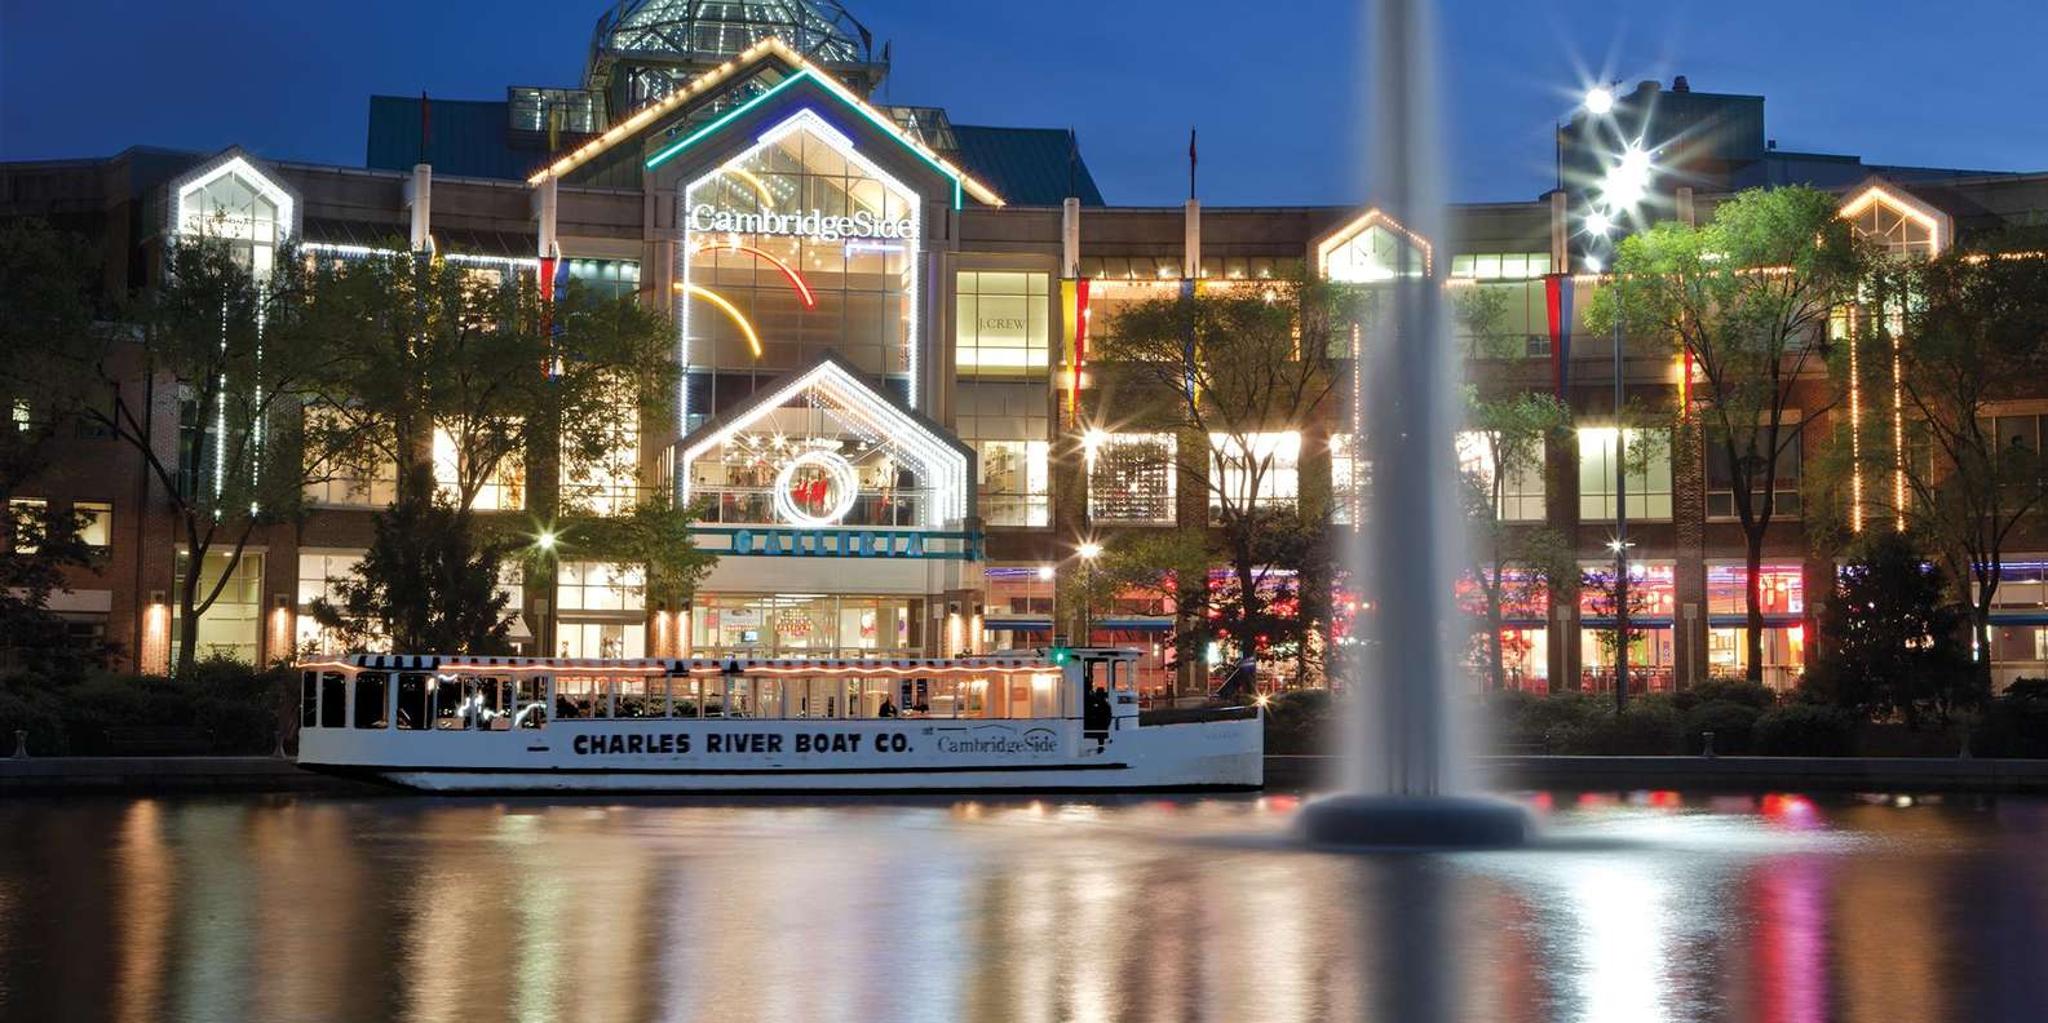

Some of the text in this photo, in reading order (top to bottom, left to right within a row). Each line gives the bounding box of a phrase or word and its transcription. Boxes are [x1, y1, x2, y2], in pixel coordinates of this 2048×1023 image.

[692, 204, 915, 240] CambridgeSide
[979, 317, 1025, 331] J.CREW
[573, 733, 914, 755] CHARLES RIVER BOAT CO.
[937, 734, 1057, 753] CambridgeSide
